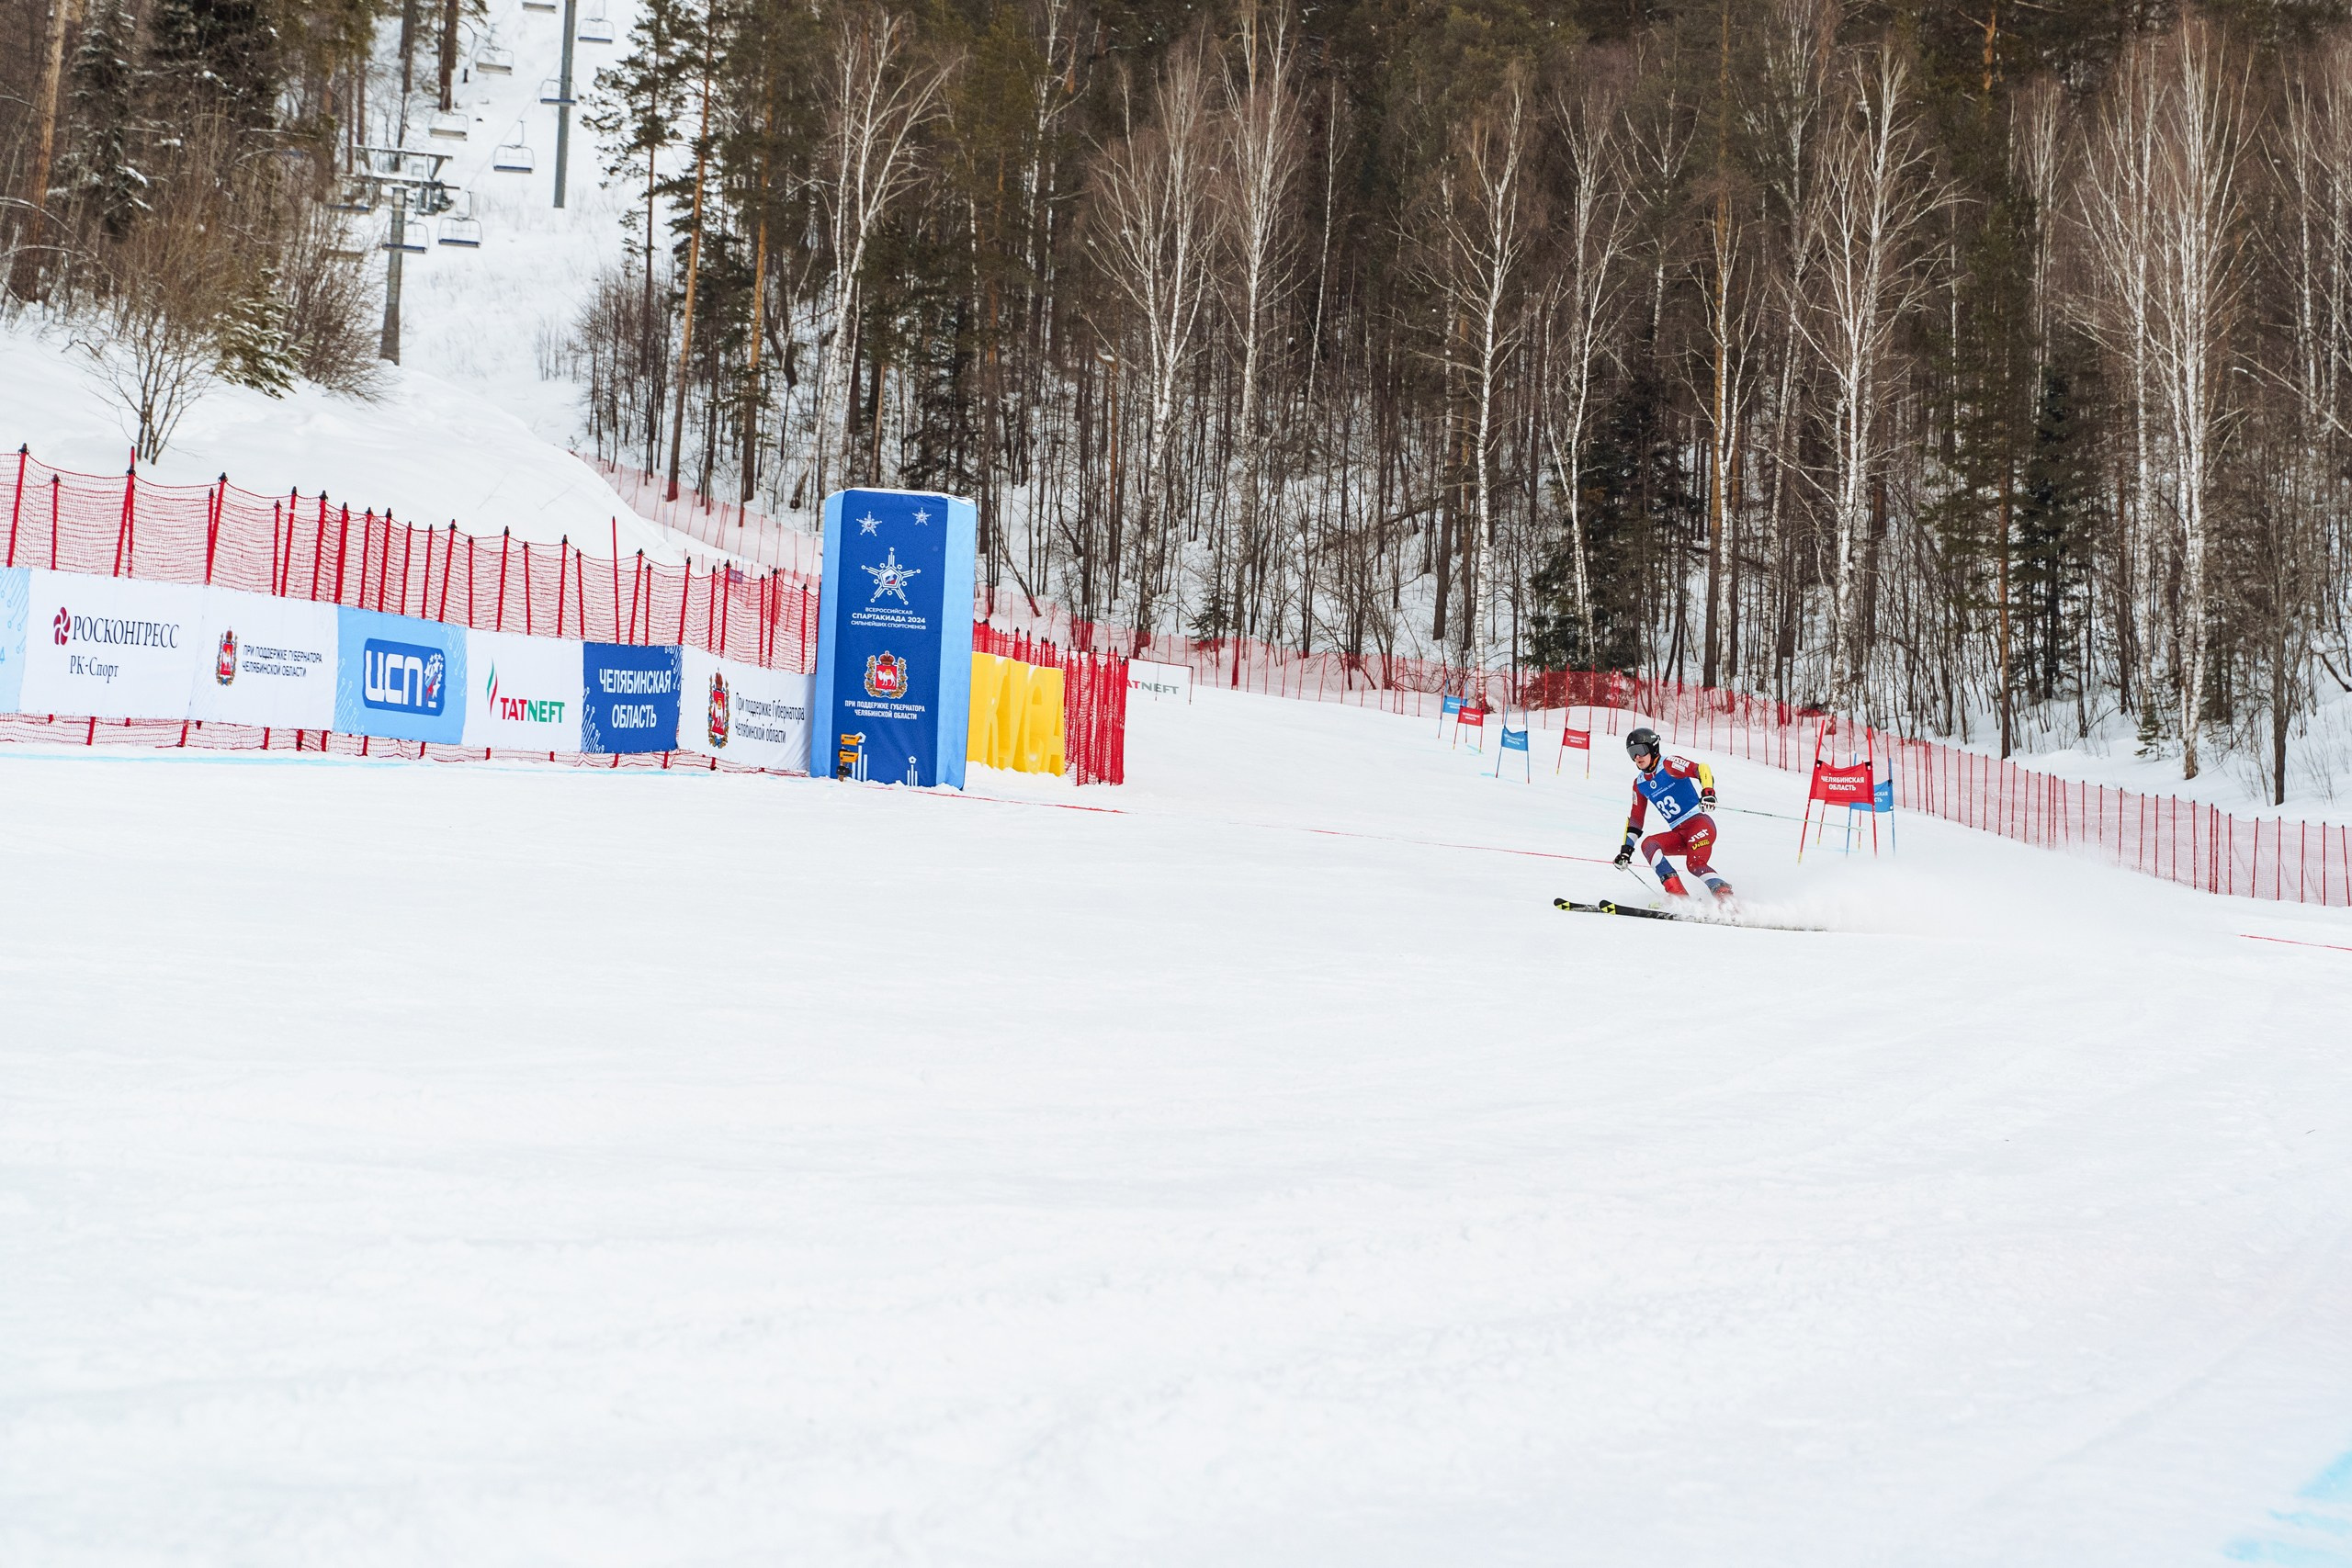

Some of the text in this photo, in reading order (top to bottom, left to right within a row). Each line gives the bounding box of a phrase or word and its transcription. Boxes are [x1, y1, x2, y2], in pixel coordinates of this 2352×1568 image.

[852, 613, 906, 623] СПАРТАКИАДА
[865, 607, 913, 615] ВСЕРОССИЙСКАЯ
[73, 615, 179, 649] РОСКОНГРЕСС
[243, 645, 322, 663] ПРИ ПОДДЕРЖКЕ ГУБЕРНАТОРА
[70, 655, 119, 683] РК-Спорт
[242, 660, 307, 677] ЧЕЛЯБИНСКОЙ ОБЛАСТИ
[599, 668, 672, 694] ЧЕЛЯБИНСКАЯ
[1126, 680, 1179, 694] ATNEFT
[500, 697, 565, 723] TATNEFT
[611, 704, 657, 728] ОБЛАСТЬ
[736, 692, 805, 725] При поддержке Губернатора
[854, 709, 917, 720] ЧЕЛЯБИНСКОЙ ОБЛАСТИ
[856, 701, 889, 709] ПОДДЕРЖКЕ
[890, 704, 926, 712] ГУБЕРНАТОРА
[735, 718, 786, 743] Челябинской области
[1821, 775, 1864, 784] ЧЕЛЯБИНСКАЯ
[1657, 795, 1681, 819] 33
